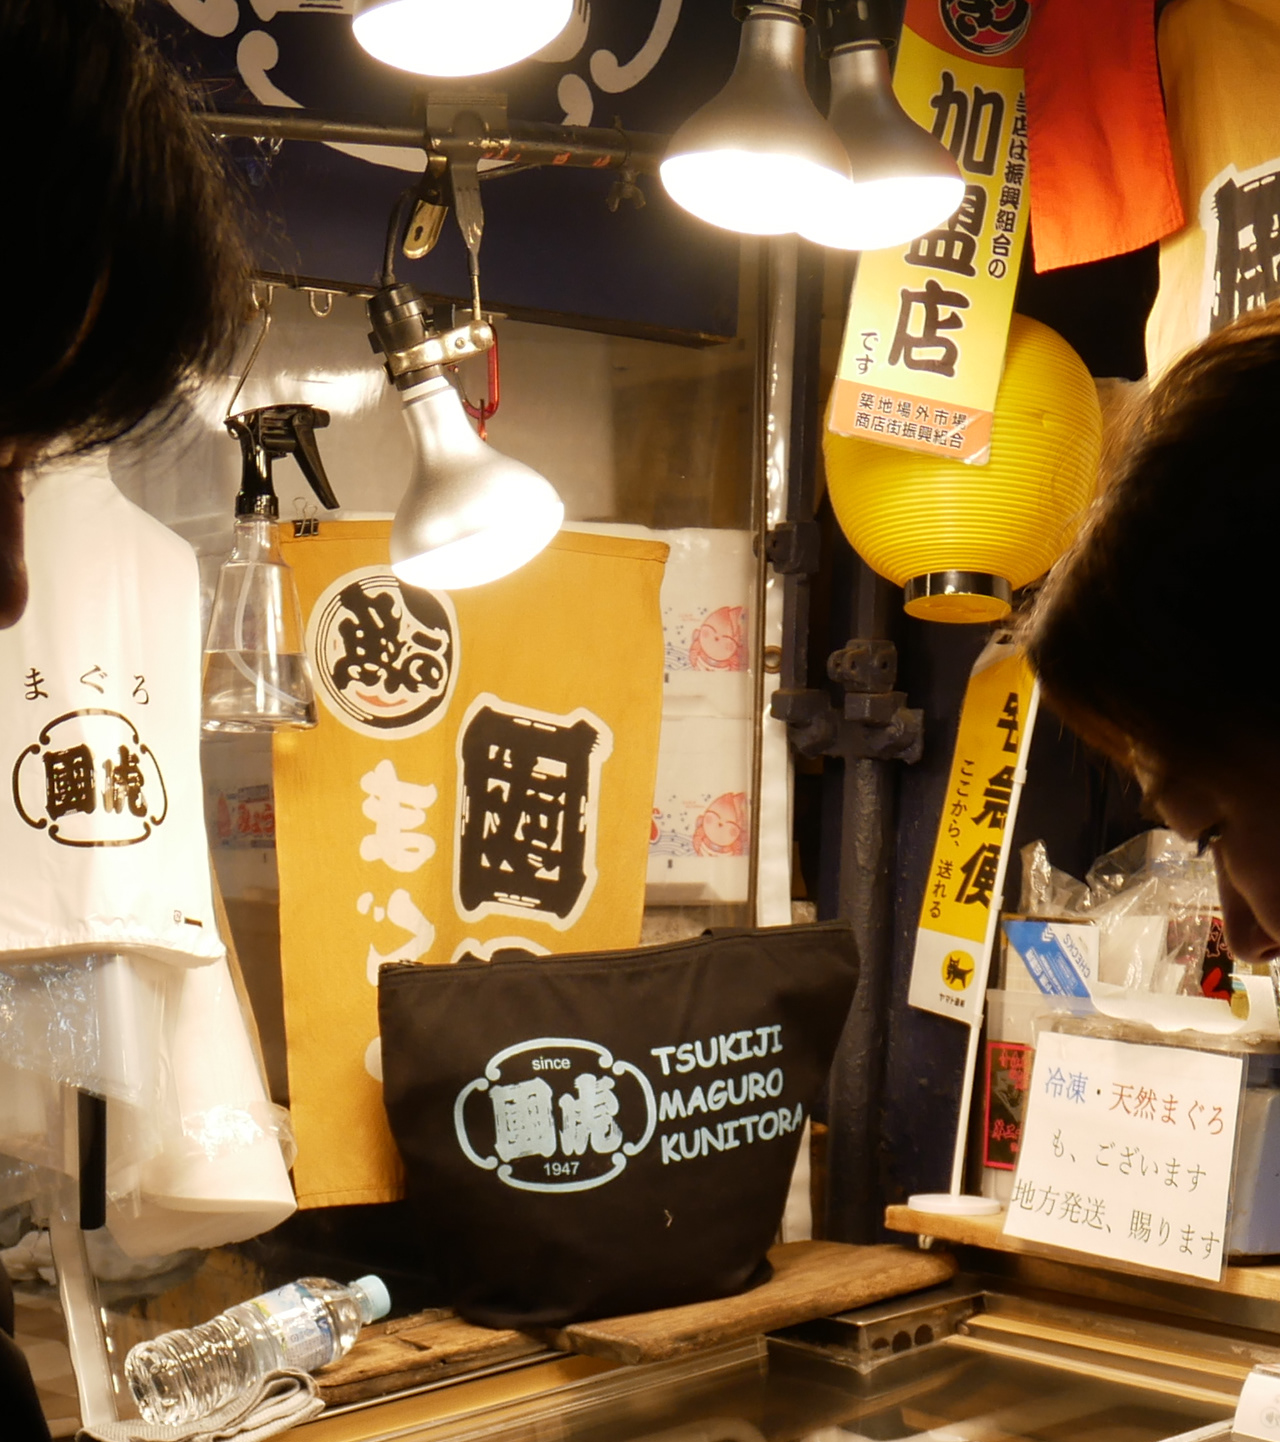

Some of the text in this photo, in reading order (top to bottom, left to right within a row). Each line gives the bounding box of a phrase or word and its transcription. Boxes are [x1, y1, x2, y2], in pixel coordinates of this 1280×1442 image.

[855, 330, 879, 375] です
[854, 411, 965, 450] 商店街振興組合
[858, 391, 967, 431] 築地場外市場
[23, 664, 149, 705] まぐろ
[929, 858, 955, 919] 送れる
[1062, 933, 1091, 979] CHECKS
[531, 1054, 572, 1072] since
[650, 1024, 782, 1077] TSUKIJI
[658, 1067, 784, 1123] MAGURO
[1045, 1066, 1224, 1135] 冷凍・天然まぐろ
[660, 1102, 803, 1165] KUNITORA
[543, 1160, 581, 1178] 1947
[1011, 1178, 1220, 1260] 地方発送、賜ります
